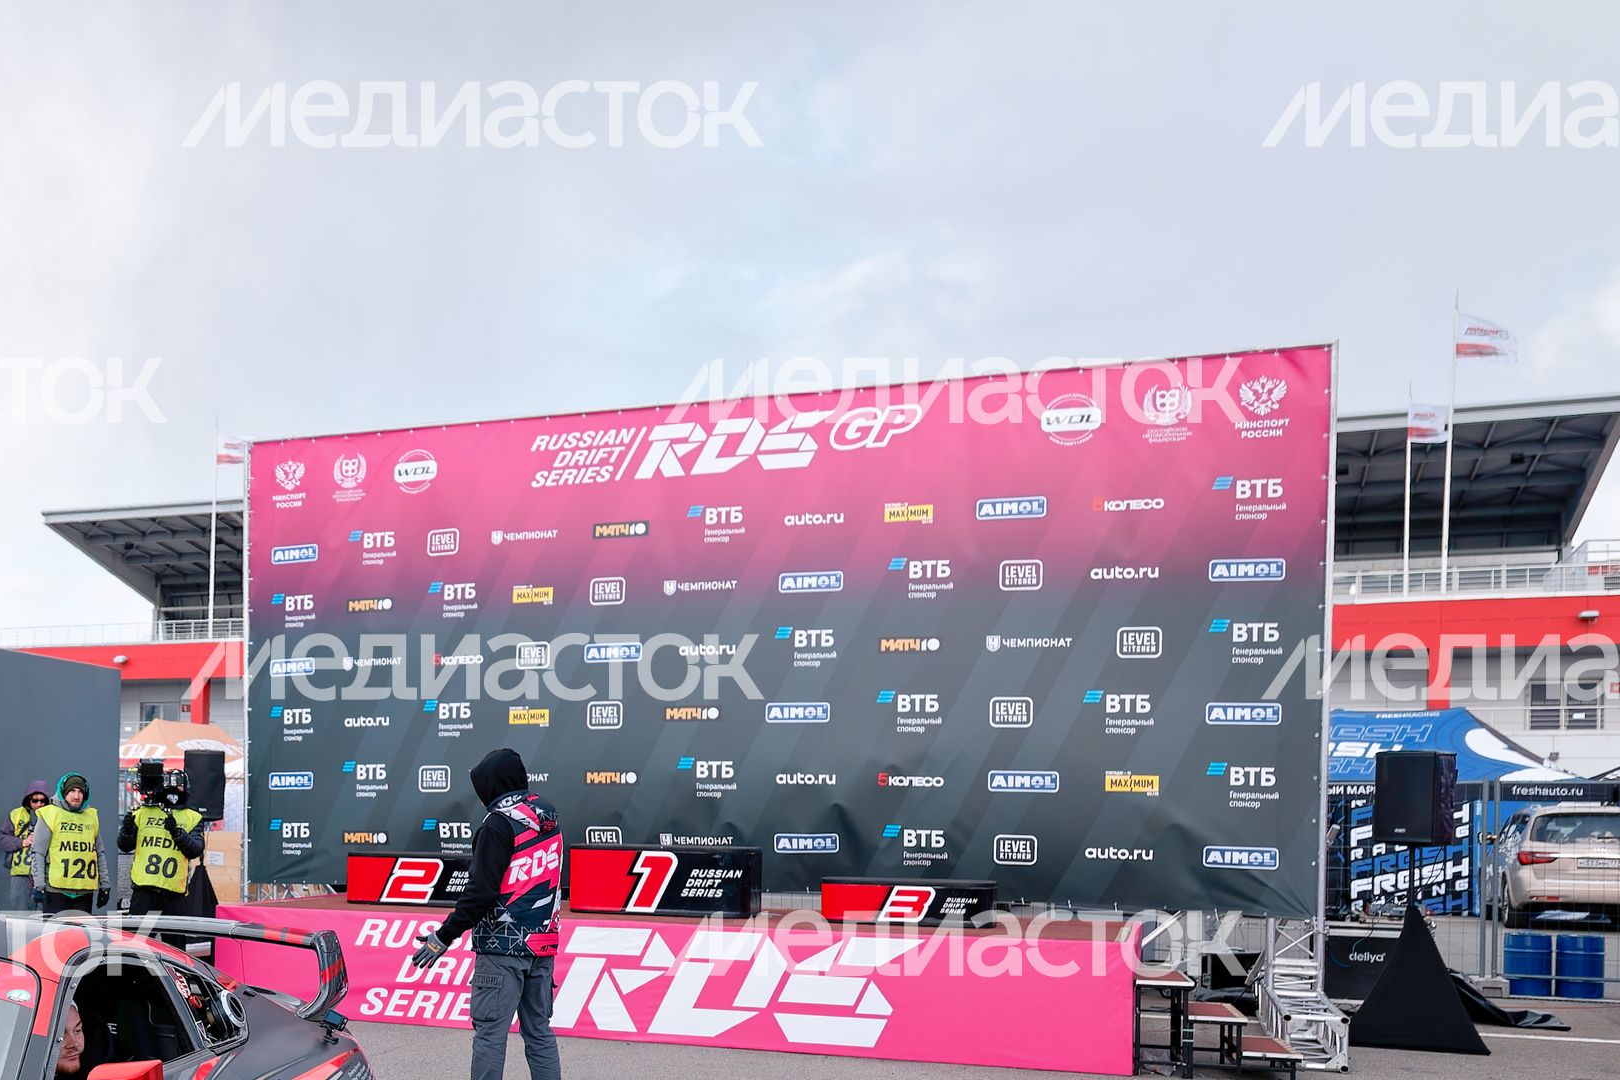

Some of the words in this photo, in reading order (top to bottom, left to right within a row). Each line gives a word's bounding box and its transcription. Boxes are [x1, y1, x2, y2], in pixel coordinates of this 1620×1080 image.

[531, 427, 636, 452] RUSSIAN
[634, 411, 836, 480] RDS
[829, 403, 923, 451] GP
[1241, 429, 1283, 439] РОССИИ
[553, 446, 626, 468] DRIFT
[531, 465, 613, 488] SERIES
[1235, 478, 1284, 499] ВТБ
[705, 506, 743, 525] ВТБ
[980, 501, 1042, 516] AIMOL
[784, 513, 844, 526] auto.ru
[363, 531, 395, 549] ВТБ
[432, 532, 455, 545] LEVEL
[504, 529, 558, 541] ЧЕМПИОНАТ
[909, 559, 951, 579] ВТБ
[1005, 565, 1037, 578] LEVEL
[1090, 566, 1159, 580] auto.ru
[1212, 562, 1283, 578] AIMOL
[595, 582, 620, 595] LEVEL
[678, 580, 737, 592] ЧЕМПИОНАТ
[782, 574, 840, 589] AIMOL
[444, 582, 476, 600] ВТБ
[285, 594, 314, 611] ВТБ
[794, 629, 835, 648] ВТБ
[1123, 632, 1156, 646] LEVEL
[1232, 622, 1280, 642] ВТБ
[679, 643, 736, 657] auto.ru
[1002, 637, 1072, 649] ЧЕМПИОНАТ
[354, 656, 403, 668] ЧЕМПИОНАТ
[897, 693, 940, 713] ВТБ
[995, 702, 1027, 715] LEVEL
[1105, 693, 1151, 714] ВТБ
[284, 707, 312, 724] ВТБ
[438, 702, 471, 720] ВТБ
[592, 705, 618, 718] LEVEL
[768, 705, 828, 720] AIMOL
[1209, 706, 1280, 722] AIMOL
[344, 716, 390, 728] auto.ru
[356, 763, 387, 780] ВТБ
[423, 769, 446, 782] LEVEL
[696, 760, 735, 779] ВТБ
[1230, 766, 1277, 787] ВТБ
[776, 772, 836, 785] auto.ru
[991, 774, 1056, 789] AIMOL
[1511, 785, 1584, 797] freshauto.ru
[282, 822, 310, 838] ВТБ
[439, 822, 473, 838] ВТБ
[590, 830, 617, 843] LEVEL
[60, 840, 96, 852] MEDIA
[141, 836, 179, 851] MEDI
[674, 836, 733, 846] ЧЕМПИОНАТ
[778, 836, 836, 850] AIMOL
[903, 829, 946, 848] ВТБ
[999, 839, 1031, 852] LEVEL
[1085, 846, 1154, 861] auto.ru
[1206, 849, 1277, 866] AIMOL
[61, 858, 97, 880] 120
[145, 854, 178, 879] 80
[508, 842, 560, 885] RDS
[380, 857, 444, 904] 2
[626, 850, 678, 913] 1
[690, 869, 743, 879] RUSSIAN
[686, 878, 723, 888] DRIFT
[681, 888, 724, 898] SERIES
[877, 885, 936, 922] 3
